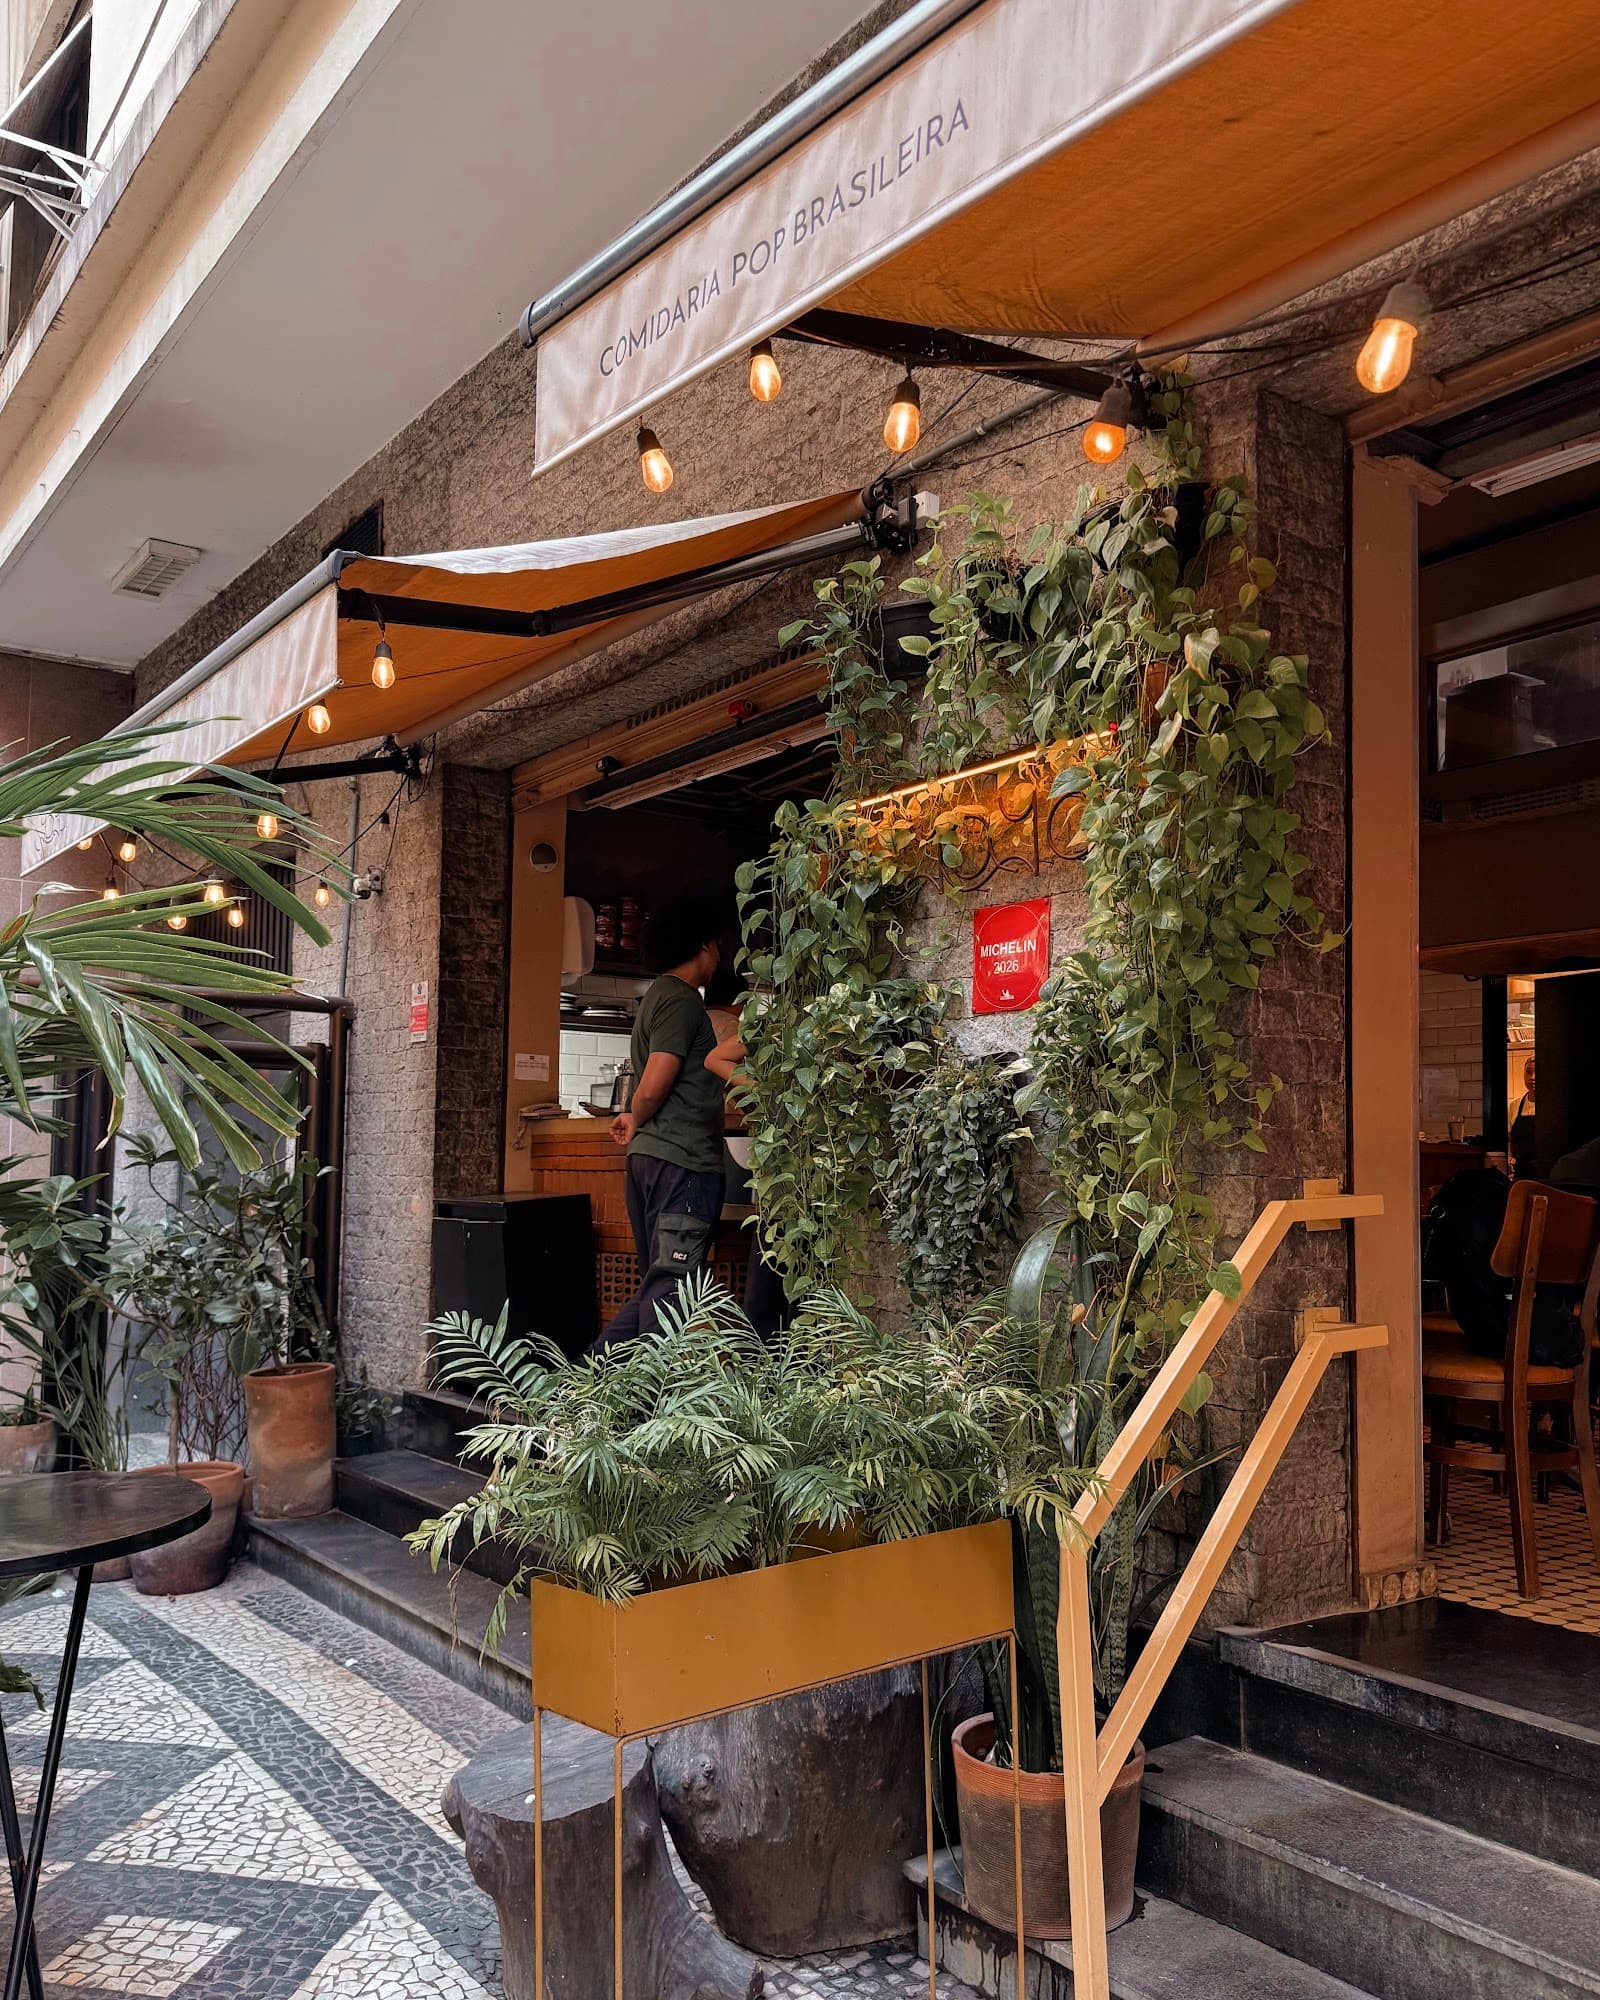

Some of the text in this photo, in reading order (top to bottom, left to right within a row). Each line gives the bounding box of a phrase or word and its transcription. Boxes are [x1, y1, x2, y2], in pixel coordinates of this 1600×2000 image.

[600, 98, 970, 377] COMIDARIA POP BRASILEIRA
[980, 939, 1037, 958] MICHELIN
[993, 959, 1019, 974] 2026
